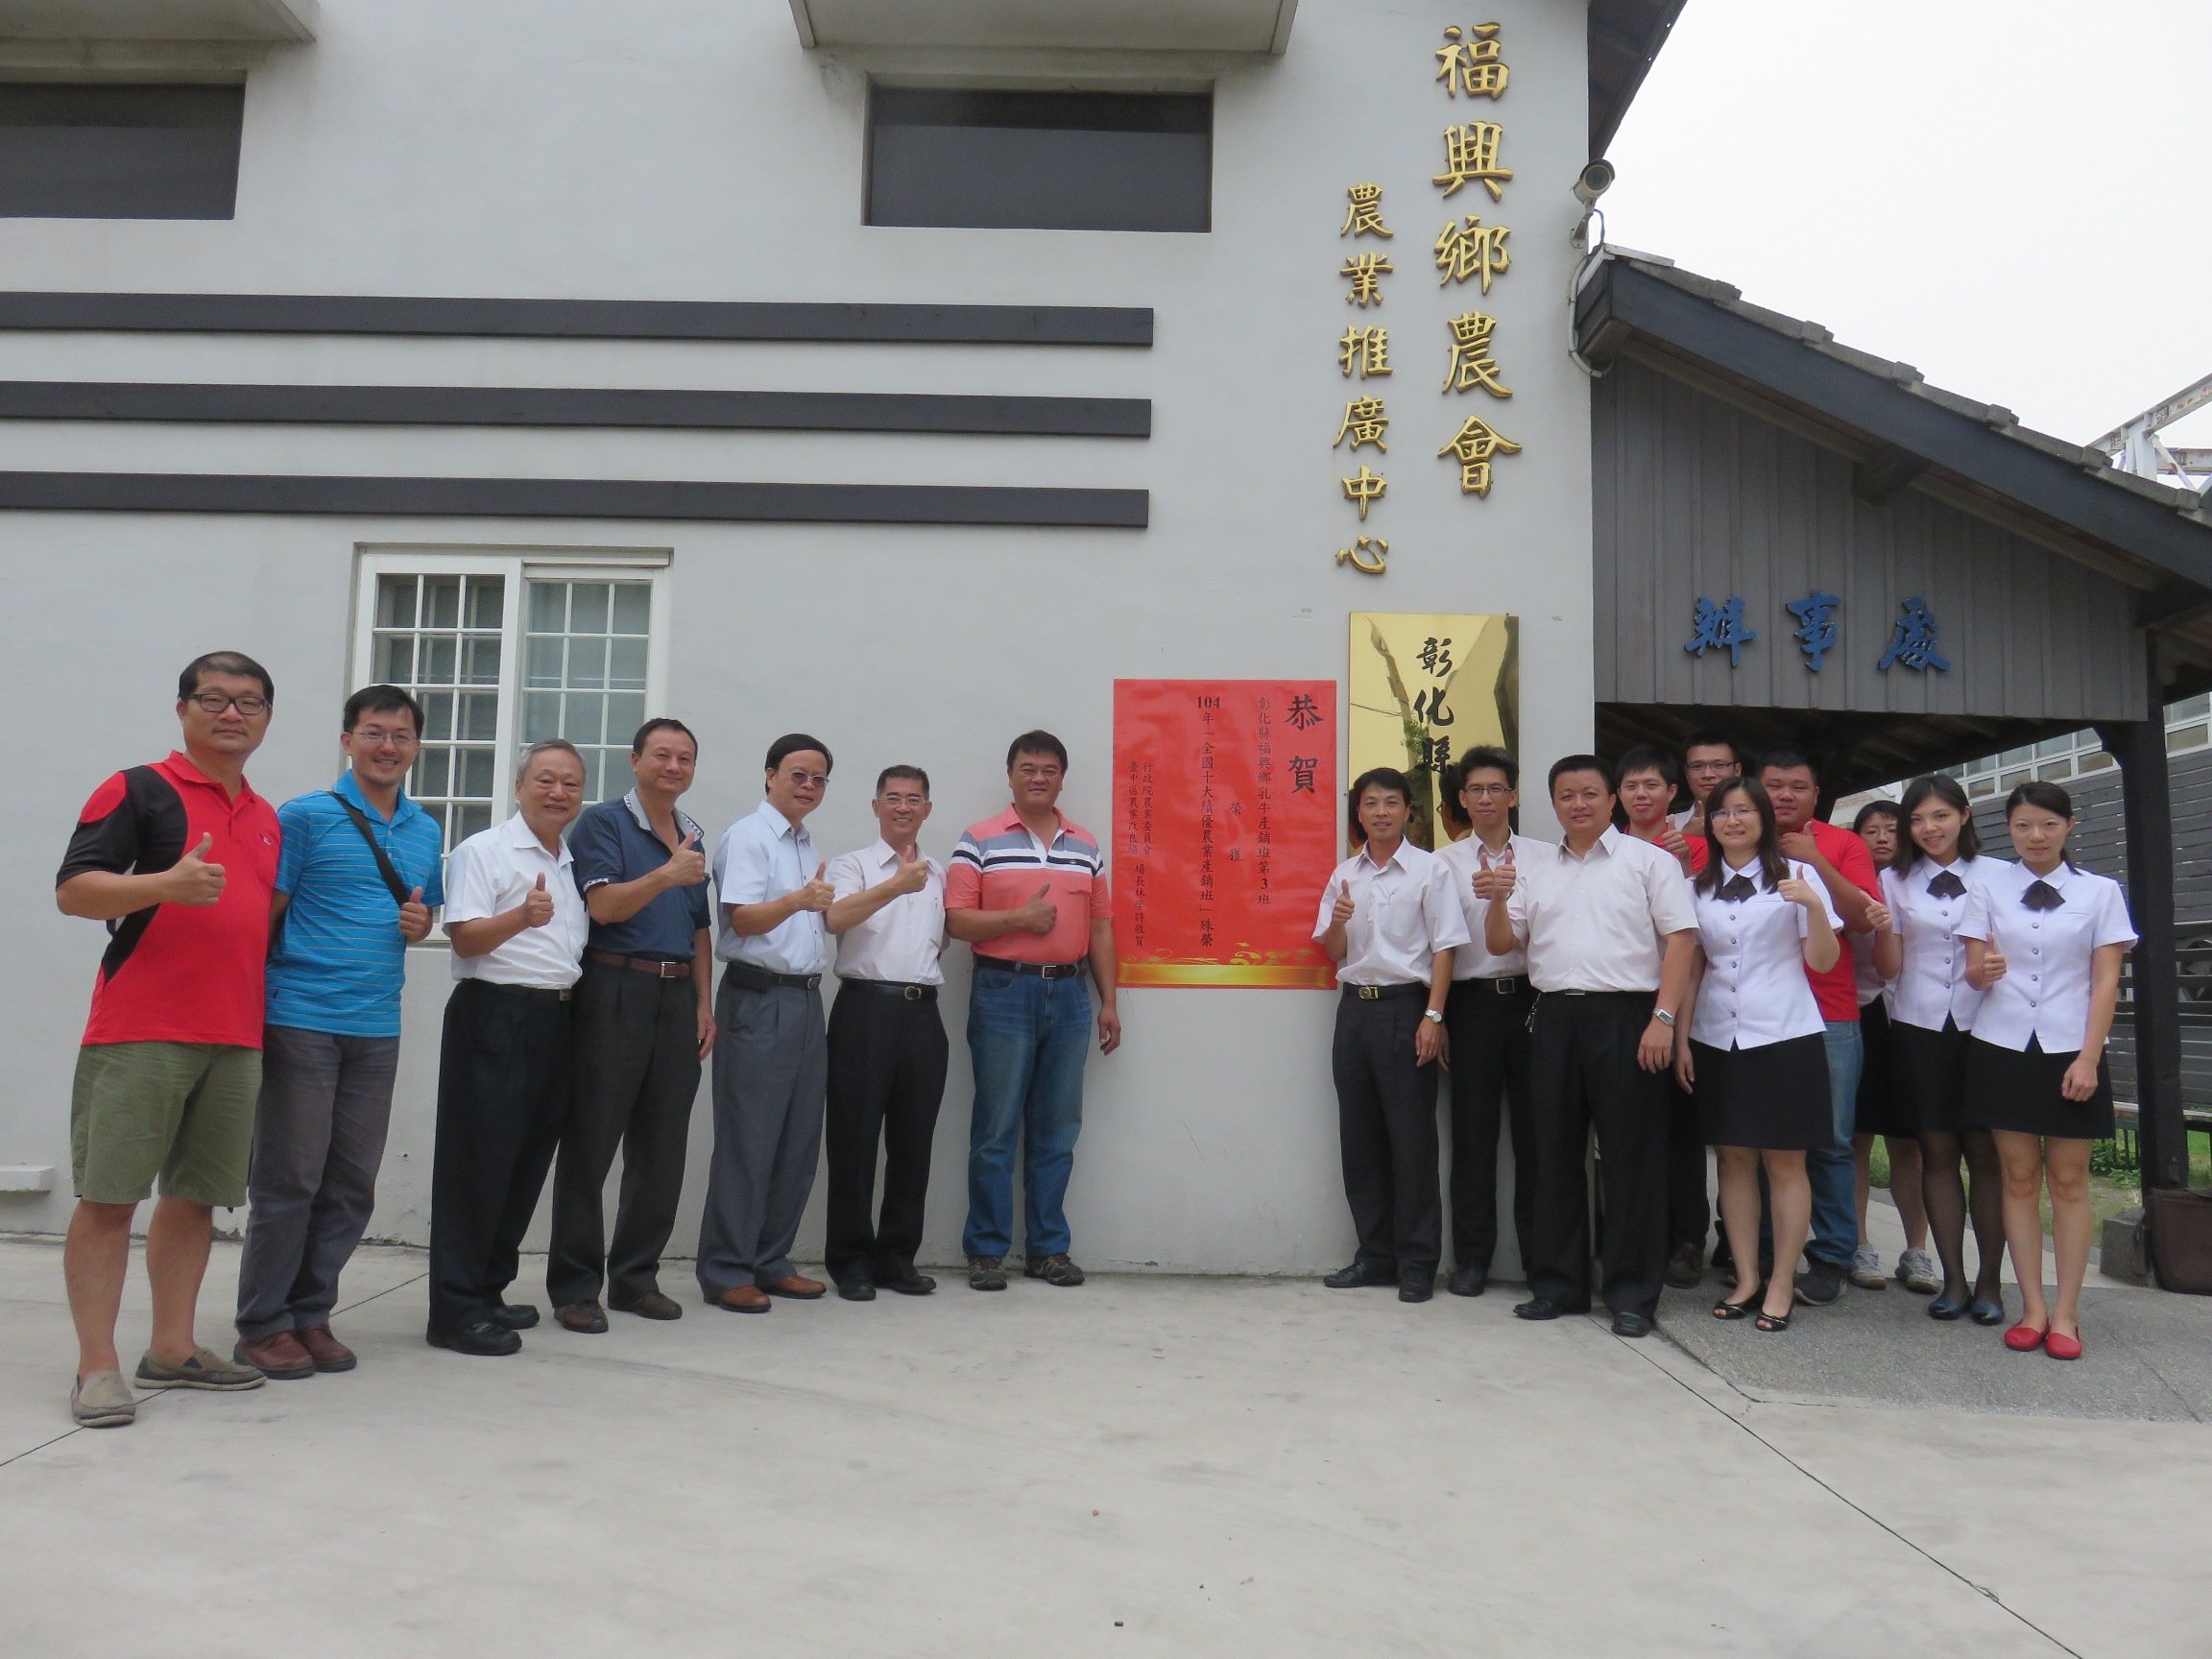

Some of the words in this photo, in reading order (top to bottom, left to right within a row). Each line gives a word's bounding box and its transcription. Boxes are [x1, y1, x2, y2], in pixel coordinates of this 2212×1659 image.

[1432, 21, 1523, 499] 福興鄉農會
[1334, 181, 1394, 575] 農業推廣中心
[1285, 693, 1324, 794] 恭賀
[1142, 761, 1154, 854] 行政院農業委員會
[1229, 802, 1242, 861] 榮獲
